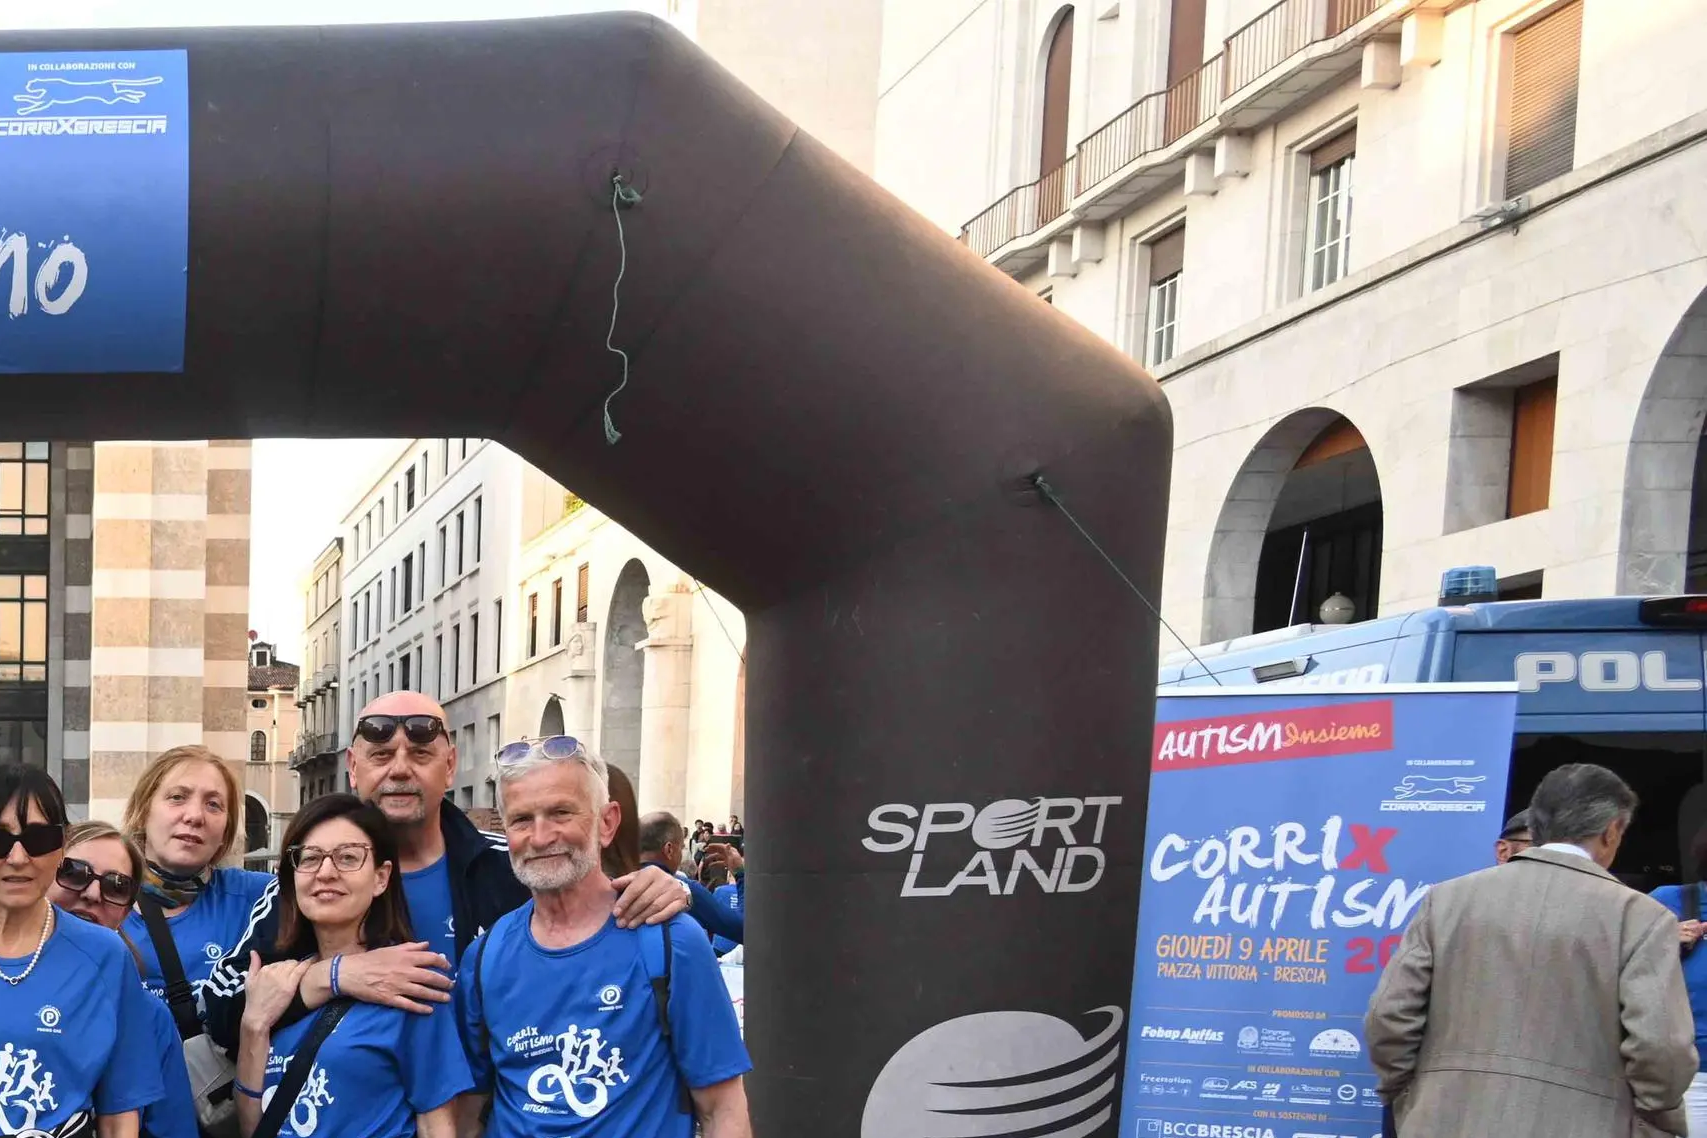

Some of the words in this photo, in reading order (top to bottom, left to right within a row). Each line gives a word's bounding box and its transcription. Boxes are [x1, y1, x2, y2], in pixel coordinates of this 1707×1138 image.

[27, 62, 38, 72] IN
[39, 62, 116, 72] COLLABORAZIONE
[117, 61, 136, 70] CON
[1514, 650, 1703, 693] POL
[860, 796, 1123, 853] SPORT
[900, 846, 1106, 898] LAND
[1192, 874, 1431, 930] AUTISM
[1156, 962, 1202, 980] PIAZZA
[1206, 964, 1259, 984] VITTORIA
[1273, 965, 1327, 985] BRESCIA
[1238, 937, 1253, 961] 9
[1259, 937, 1330, 964] APRILE
[1345, 935, 1404, 974] 20
[514, 1034, 554, 1052] AUTISMO
